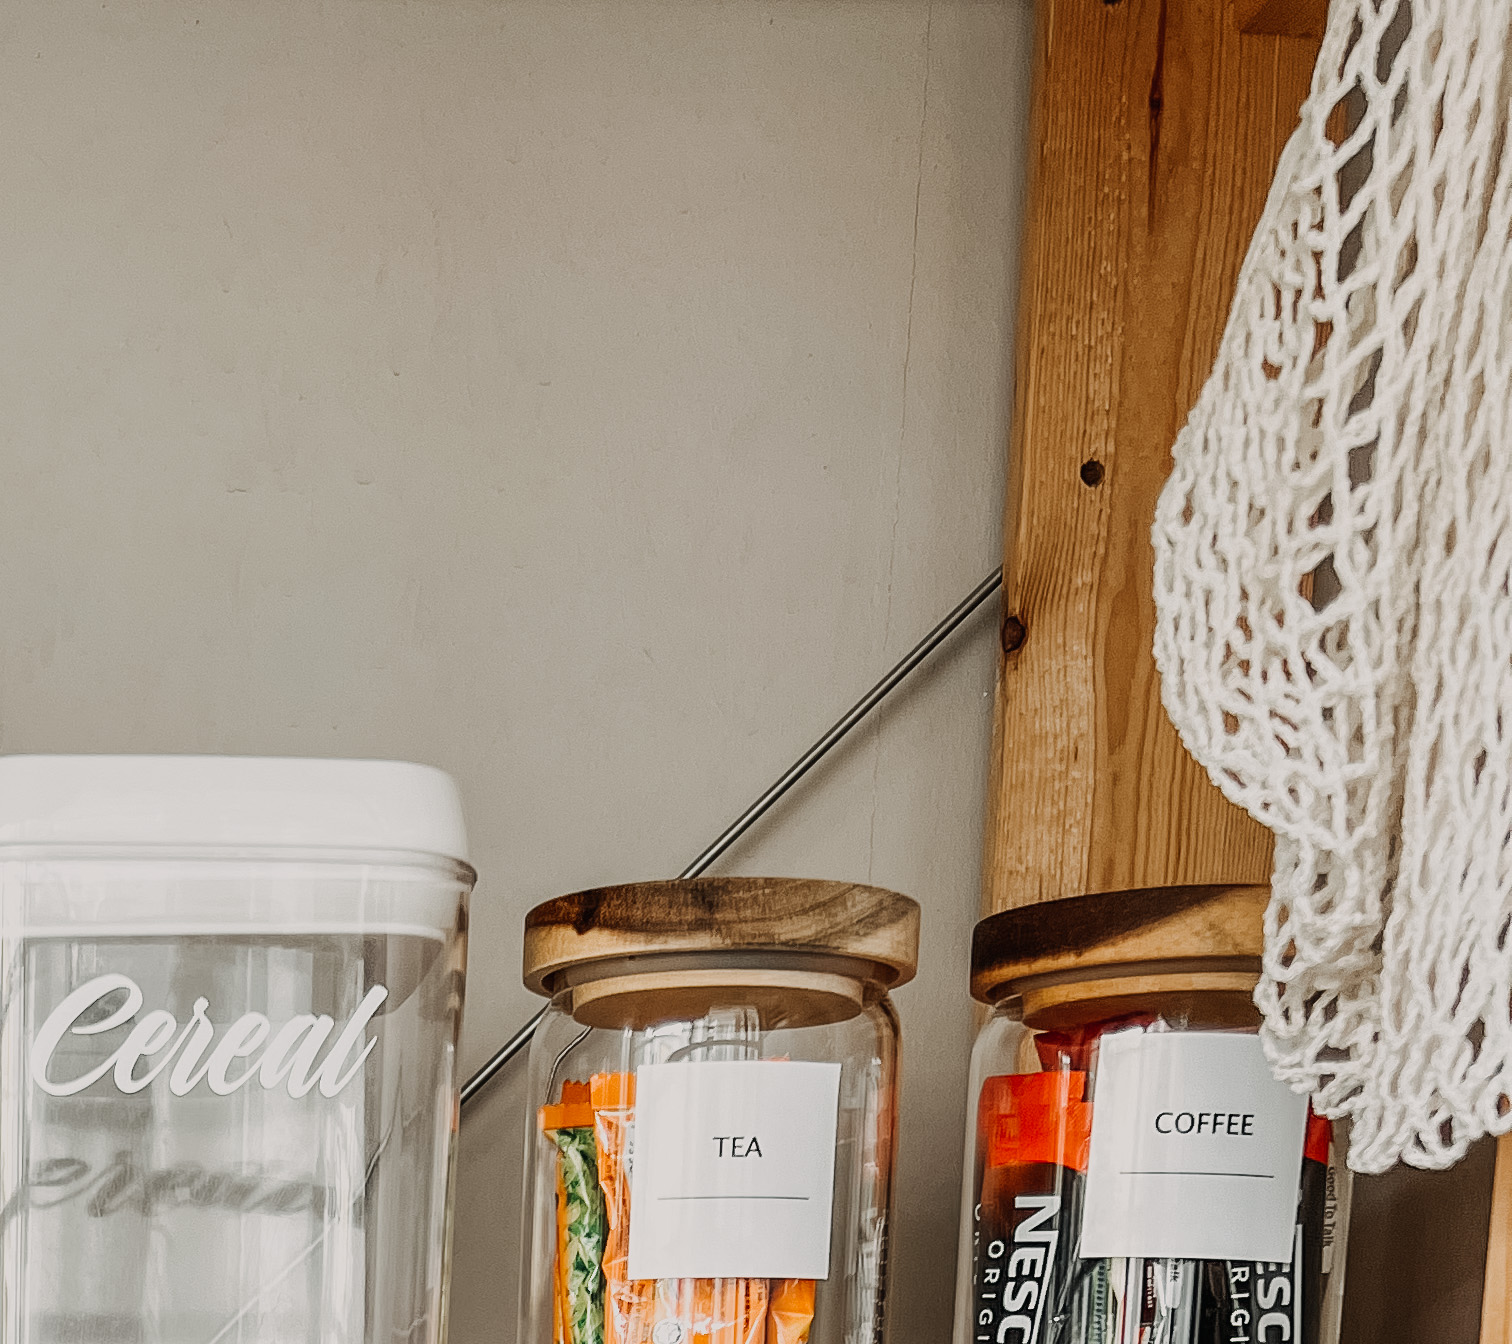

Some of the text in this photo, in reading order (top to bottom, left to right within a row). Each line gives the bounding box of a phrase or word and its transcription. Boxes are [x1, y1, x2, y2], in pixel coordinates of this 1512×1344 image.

[32, 973, 389, 1098] Cereal
[1155, 1112, 1255, 1136] COFFEE
[713, 1137, 763, 1158] TEA
